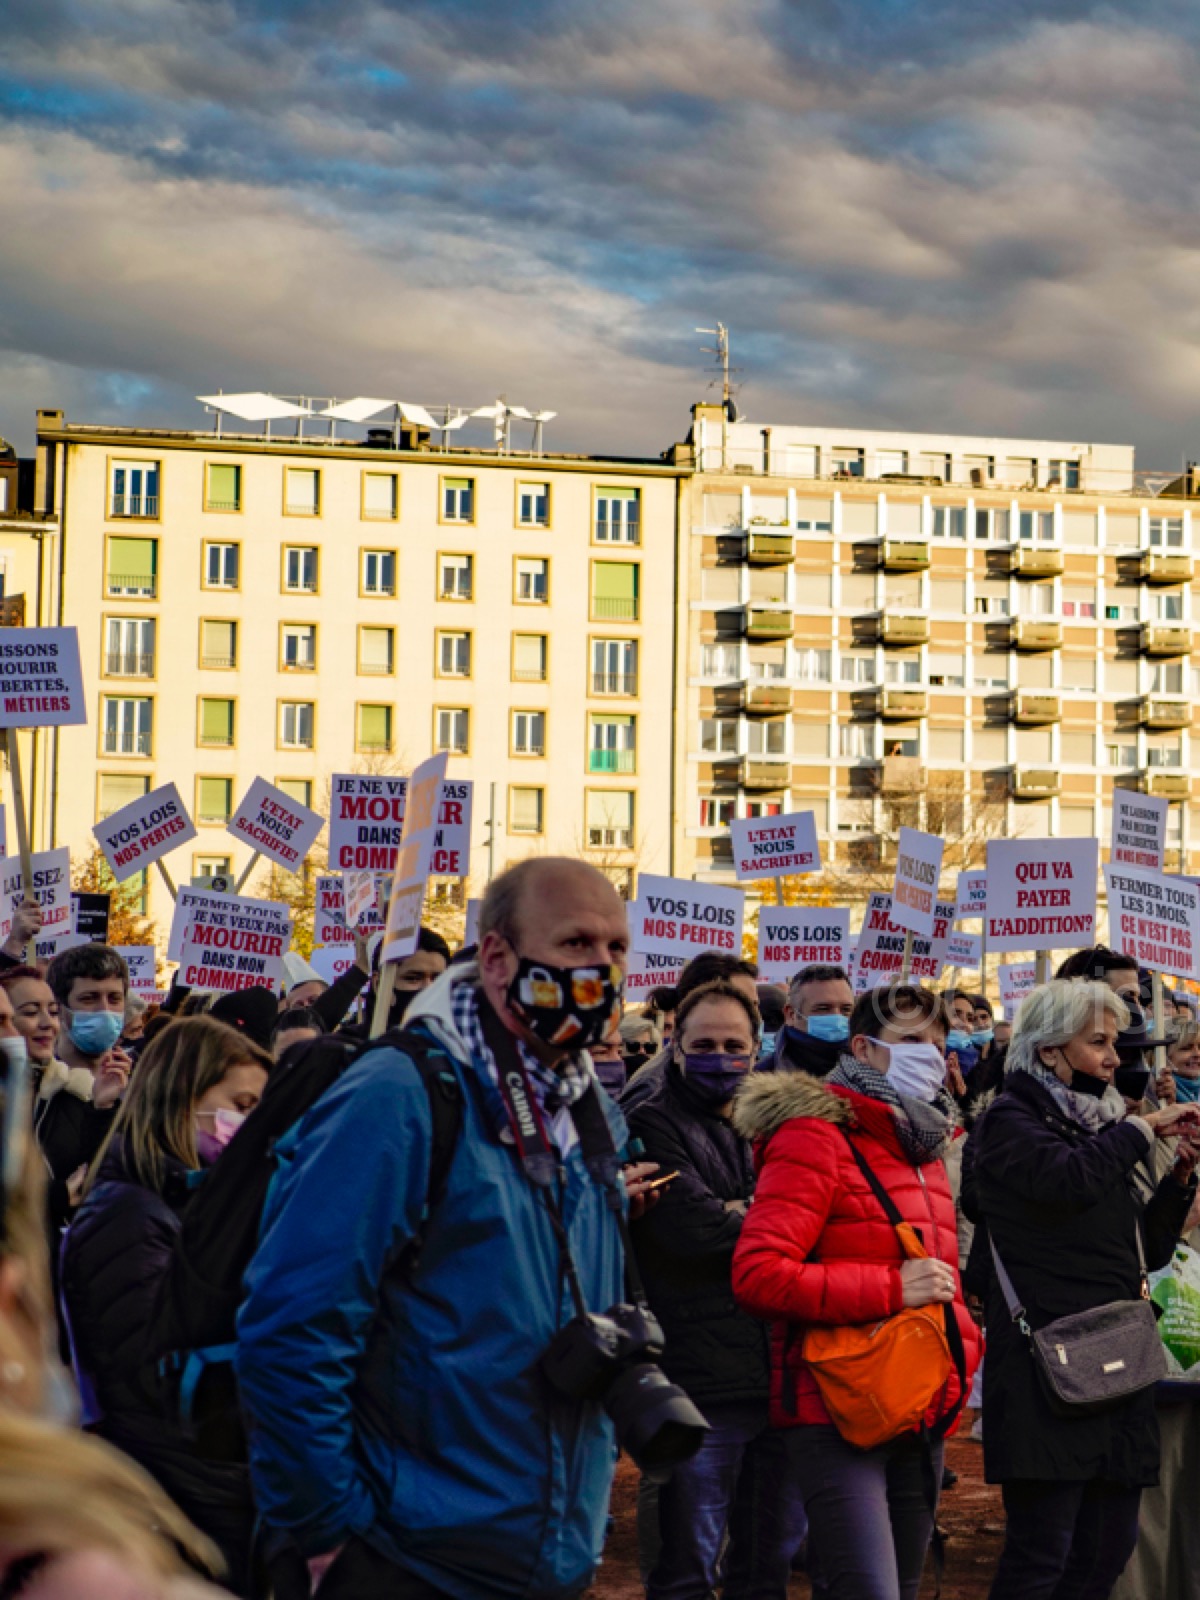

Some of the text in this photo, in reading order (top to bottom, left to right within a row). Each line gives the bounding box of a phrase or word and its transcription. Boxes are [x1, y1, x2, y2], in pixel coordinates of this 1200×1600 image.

[5, 694, 70, 712] MÉTIERS
[336, 780, 355, 793] JE
[359, 780, 382, 794] NE
[106, 801, 177, 849] VOS LOIS
[256, 811, 293, 840] NOUS
[260, 796, 304, 830] L'ETAT
[113, 815, 186, 867] NOS PERTES
[236, 817, 299, 862] SACRIFIE!
[358, 826, 401, 844] DANS
[748, 826, 796, 842] L'ETAT
[752, 840, 795, 855] NOUS
[741, 852, 813, 872] SACRIFIE!
[914, 859, 936, 886] LOIS
[1015, 862, 1073, 882] QUI VA
[1016, 889, 1071, 908] PAYER
[1110, 874, 1162, 900] FERMER
[1165, 887, 1197, 909] TOUS
[646, 896, 735, 926] VOS LOIS
[871, 896, 884, 908] JE
[934, 905, 954, 918] PAS
[1120, 894, 1190, 927] LES 3 MOIS,
[194, 910, 290, 936] JE NE VEUX PAS
[643, 918, 735, 949] NOS PERTES
[766, 926, 842, 942] VOS LOIS
[989, 914, 1093, 937] L'ADDITION?
[1120, 914, 1192, 949] CE N'EST PAS
[191, 923, 283, 957] MOURIR
[876, 936, 906, 952] DANS
[202, 950, 266, 974] DANS MON
[764, 945, 842, 962] NOS PERTES
[860, 949, 938, 976] COMMRCE
[1122, 936, 1193, 971] LA SOLUTION
[185, 965, 275, 991] COMMERCE
